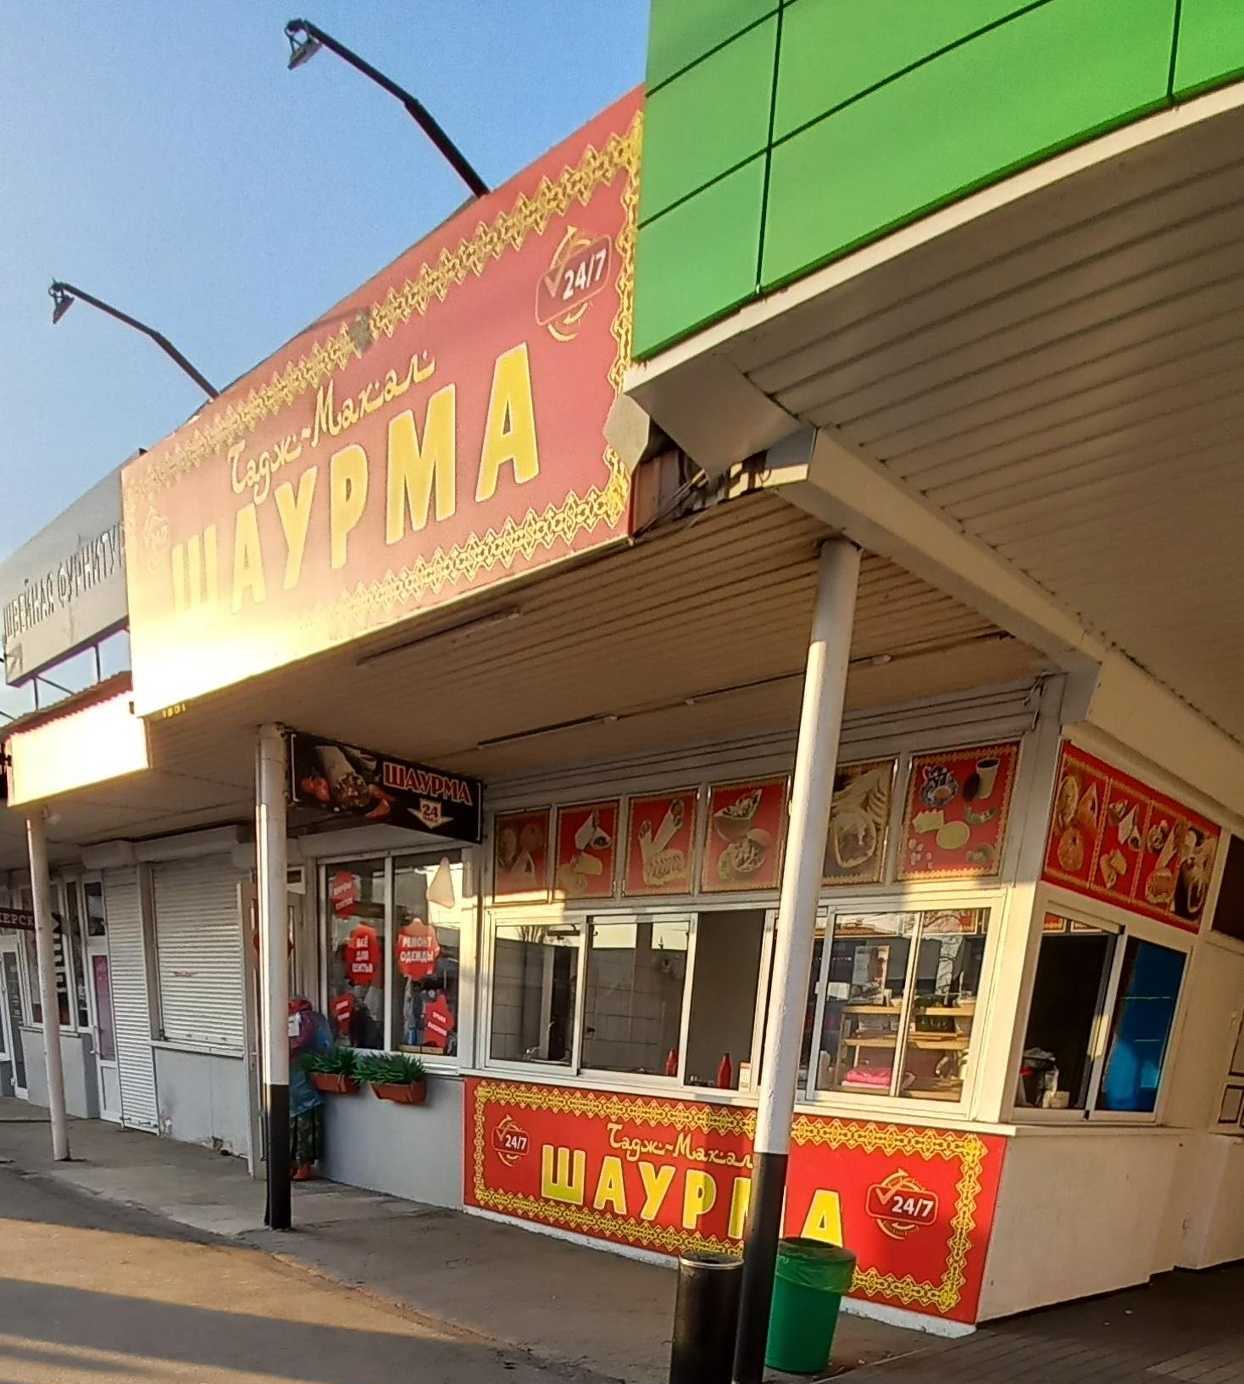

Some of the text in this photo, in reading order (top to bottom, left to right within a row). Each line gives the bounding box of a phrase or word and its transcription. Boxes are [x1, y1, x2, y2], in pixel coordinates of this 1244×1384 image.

[563, 248, 607, 301] 24/7
[228, 350, 436, 505] Тадж-Махал
[171, 342, 540, 615] ШАУРМА
[383, 761, 473, 807] ШАУРМА
[422, 804, 438, 818] 24
[400, 951, 434, 964] ОДЕЖДЫ
[504, 1133, 528, 1151] 24/7
[892, 1195, 934, 1218] 24/7
